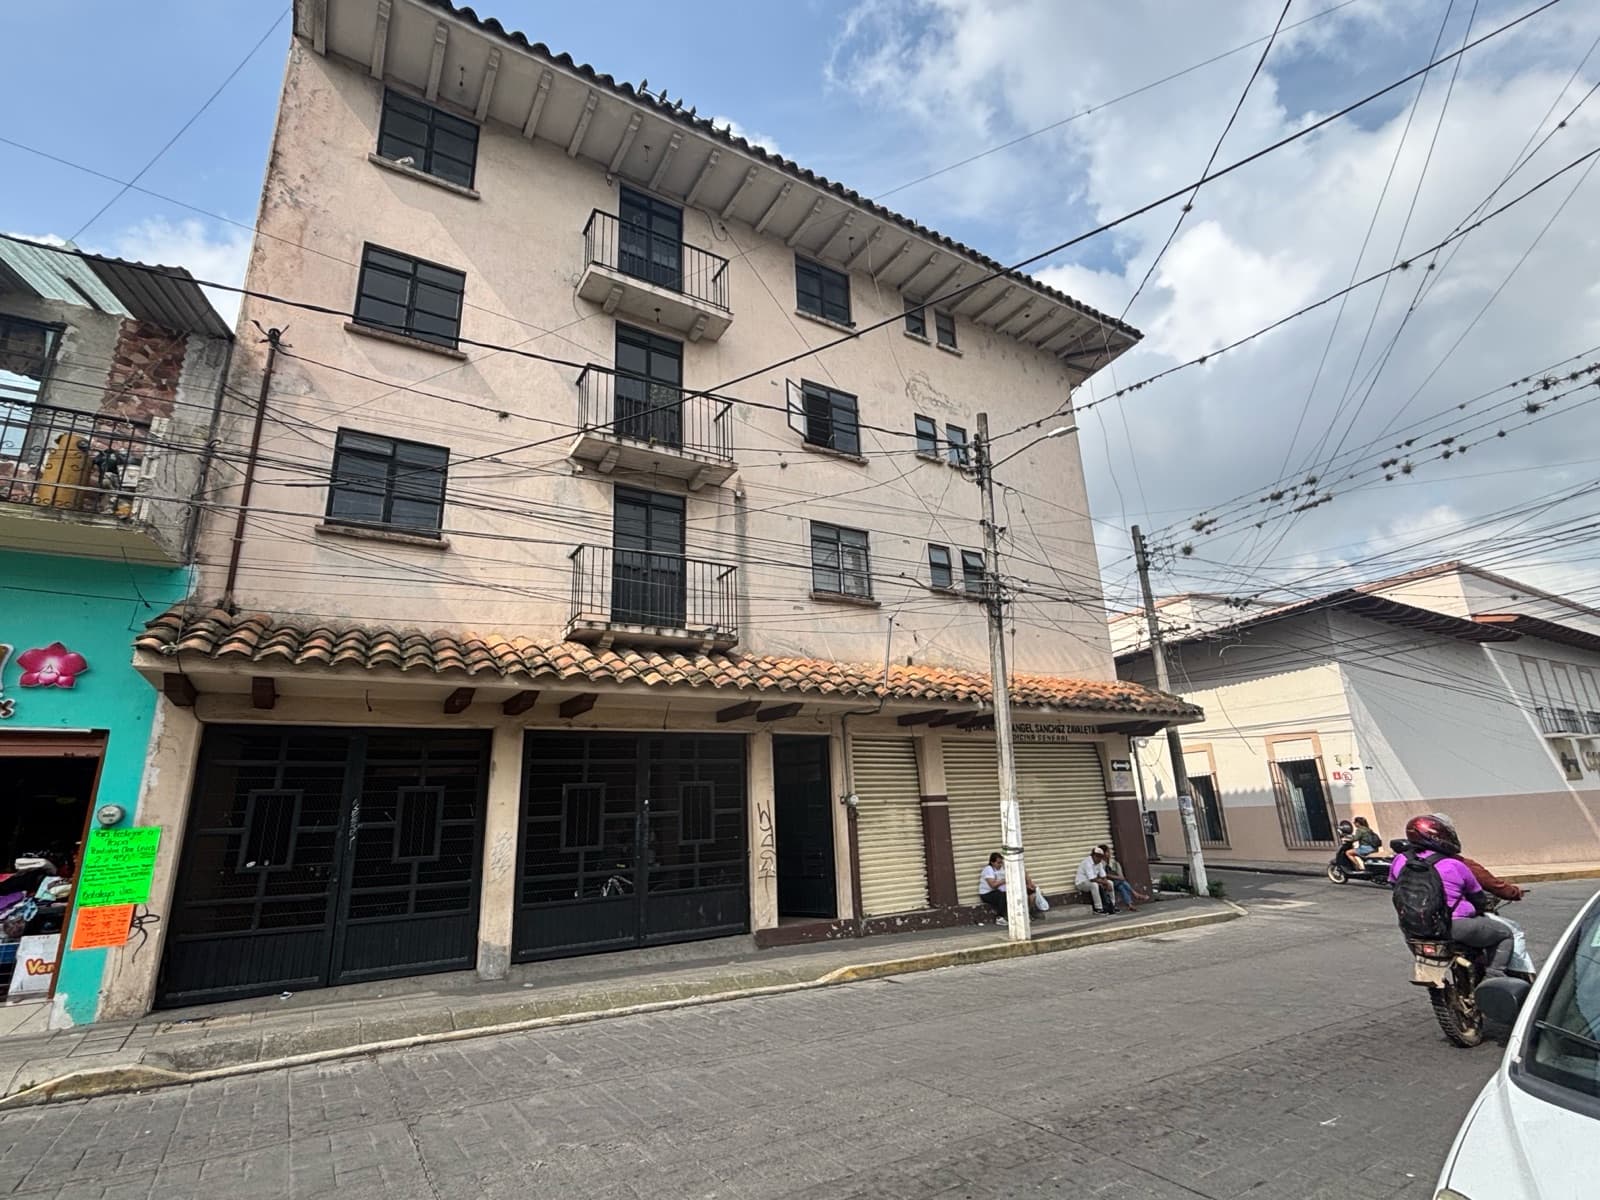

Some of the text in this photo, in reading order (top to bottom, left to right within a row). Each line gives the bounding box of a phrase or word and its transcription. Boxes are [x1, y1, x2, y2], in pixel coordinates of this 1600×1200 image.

[1012, 723, 1033, 733] ANGEL
[1034, 723, 1066, 734] SANCHEZ
[1038, 734, 1069, 743] GENERAL
